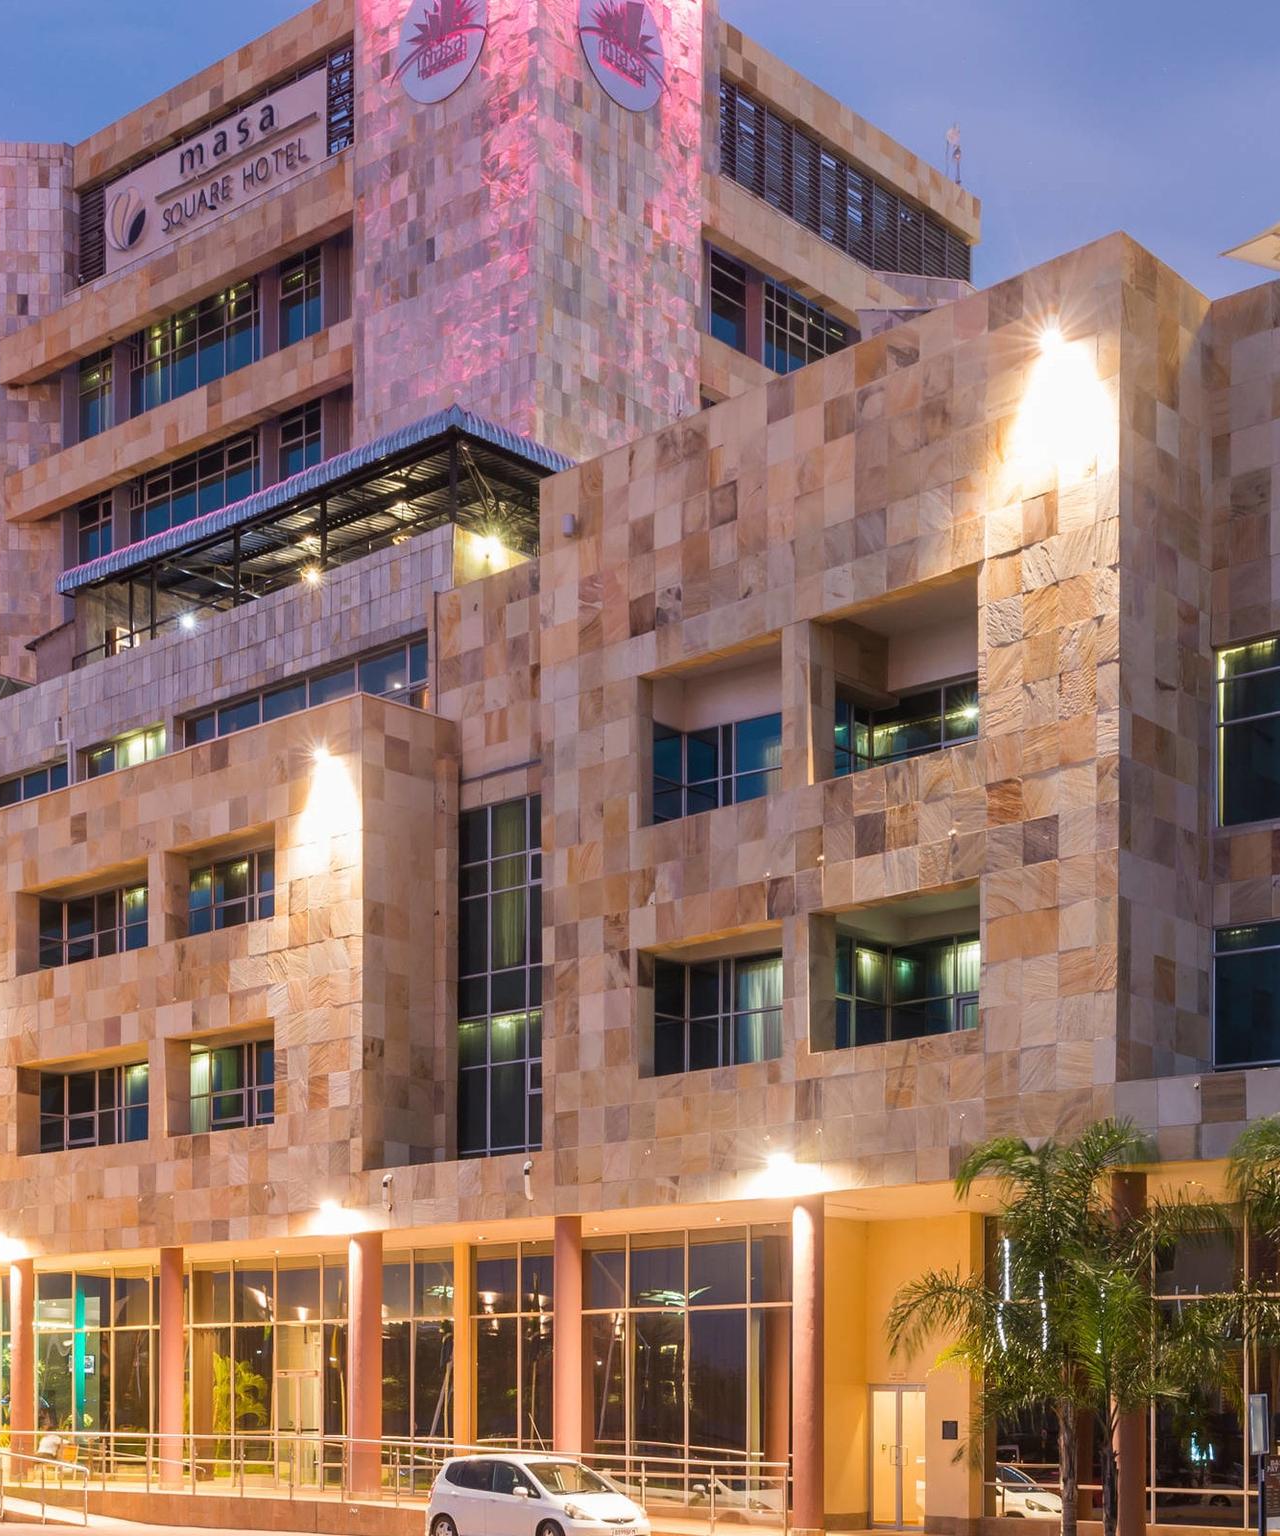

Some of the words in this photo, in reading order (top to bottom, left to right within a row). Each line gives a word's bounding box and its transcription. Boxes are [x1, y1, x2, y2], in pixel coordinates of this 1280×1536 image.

[179, 103, 275, 174] masa
[162, 175, 230, 232] SQUARE
[243, 138, 308, 191] HOTEL
